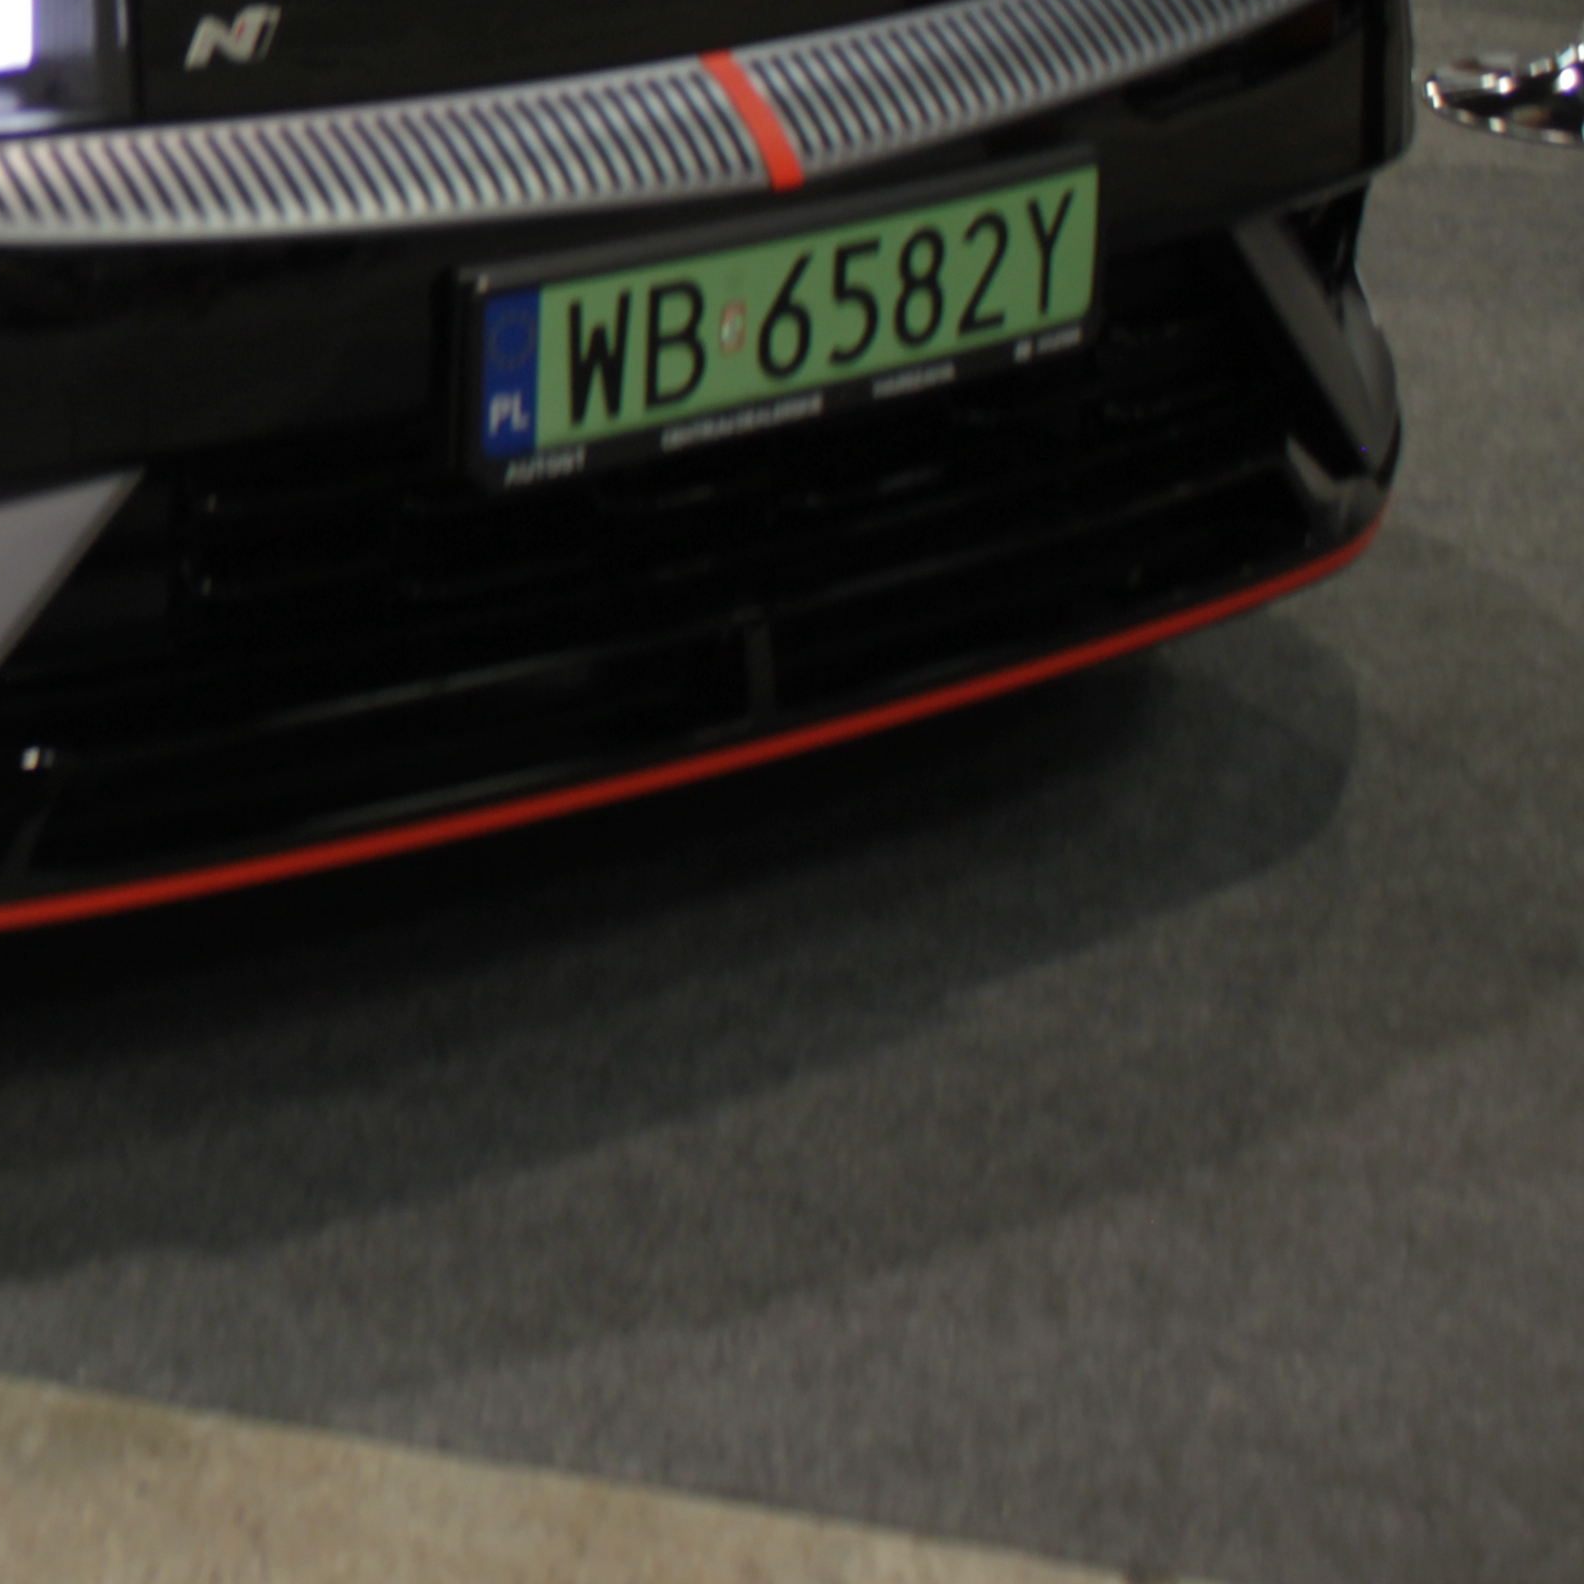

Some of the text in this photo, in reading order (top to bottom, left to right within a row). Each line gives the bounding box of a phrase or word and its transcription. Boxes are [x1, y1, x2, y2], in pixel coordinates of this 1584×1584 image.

[566, 188, 1076, 430] WB 6582Y
[487, 390, 530, 436] PL
